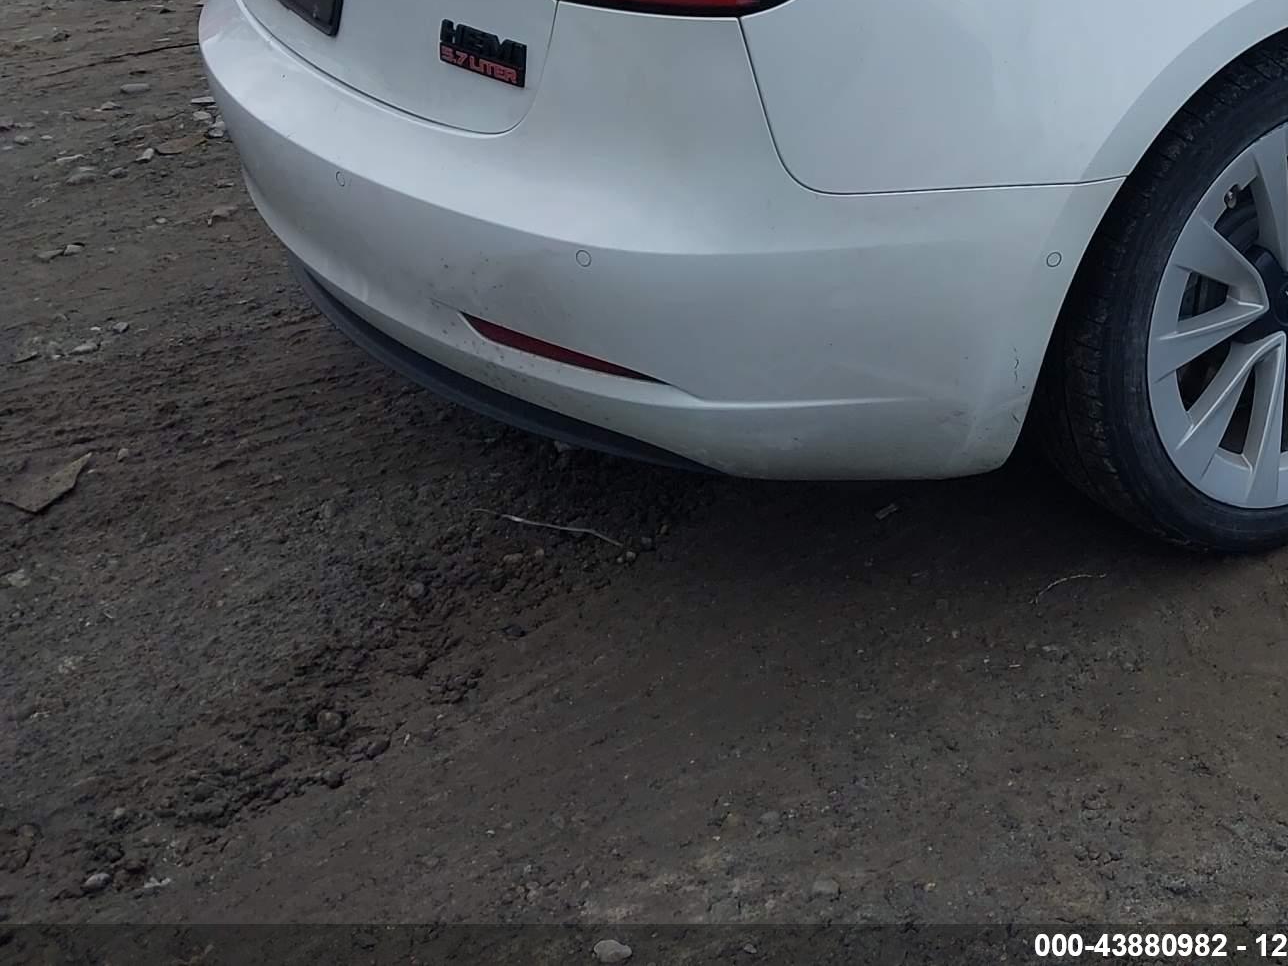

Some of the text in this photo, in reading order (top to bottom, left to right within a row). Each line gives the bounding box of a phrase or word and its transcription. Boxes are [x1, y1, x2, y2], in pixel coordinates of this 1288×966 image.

[440, 19, 527, 68] HEMI
[441, 46, 517, 84] 5.7 LITER
